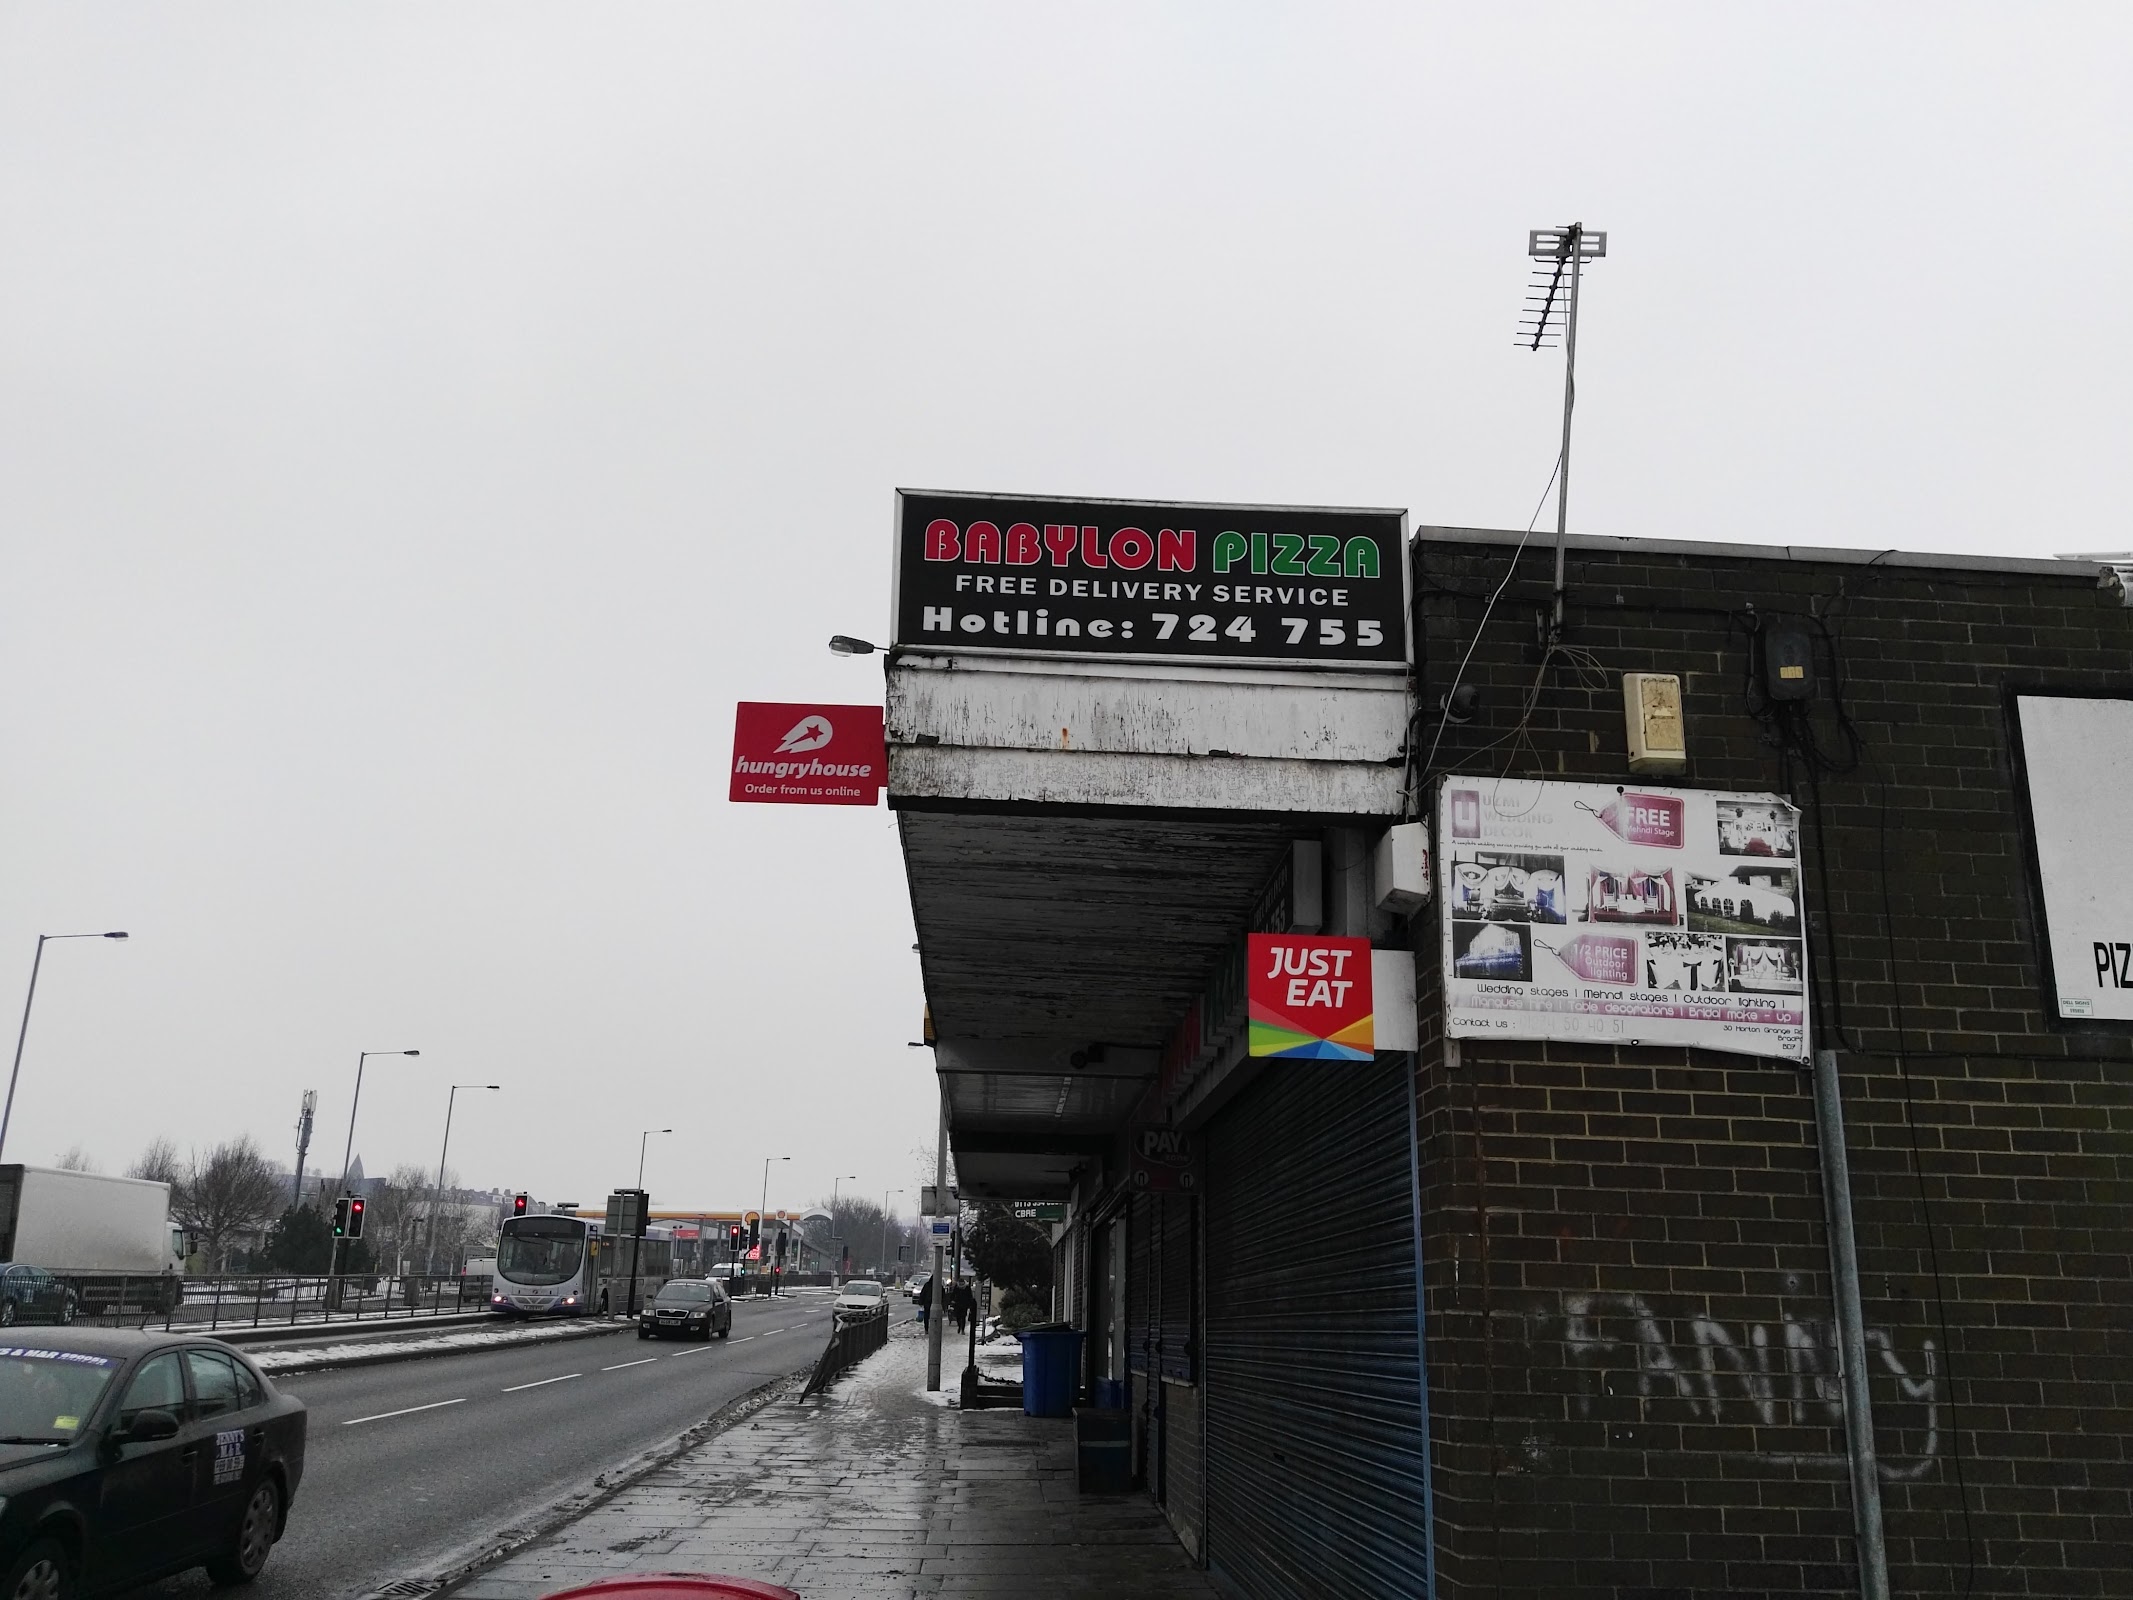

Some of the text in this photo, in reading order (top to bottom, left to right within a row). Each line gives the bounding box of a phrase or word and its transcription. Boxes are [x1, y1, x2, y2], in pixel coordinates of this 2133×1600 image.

[923, 518, 1381, 578] BABYLON PIZZA
[955, 574, 1350, 607] FREE DELIVERY SERVICE
[922, 606, 1384, 647] Hotline: 724 755
[735, 755, 871, 779] hungryhouse
[745, 783, 861, 797] Order from us online
[1627, 806, 1670, 827] FREE
[1654, 828, 1675, 837] Stage
[1267, 947, 1352, 979] JUST
[1585, 956, 1624, 968] Outdoor
[1594, 945, 1628, 959] PRICE
[1590, 967, 1628, 981] lighting
[2093, 941, 2133, 989] PIZ
[1285, 979, 1353, 1008] EAT
[1477, 983, 1524, 996] Wedding
[1530, 986, 1569, 998] stages
[1583, 989, 1624, 1000] Mehndi
[1629, 993, 1669, 1003] stages
[1683, 994, 1732, 1005] Outdoor
[1738, 997, 1776, 1009] lighting
[1470, 995, 1523, 1009] Marquee
[1567, 1000, 1599, 1012] Table
[1605, 1002, 1674, 1016] decorations
[1689, 1007, 1721, 1018] Bridal
[1727, 1009, 1758, 1021] make
[1776, 1012, 1792, 1023] up
[1452, 1017, 1490, 1028] Contact
[1612, 1019, 1625, 1034] 51
[1723, 1024, 1733, 1032] 30
[1764, 1027, 1791, 1035] Grange
[1144, 1131, 1183, 1155] PAY
[1015, 1208, 1037, 1218] CBRE
